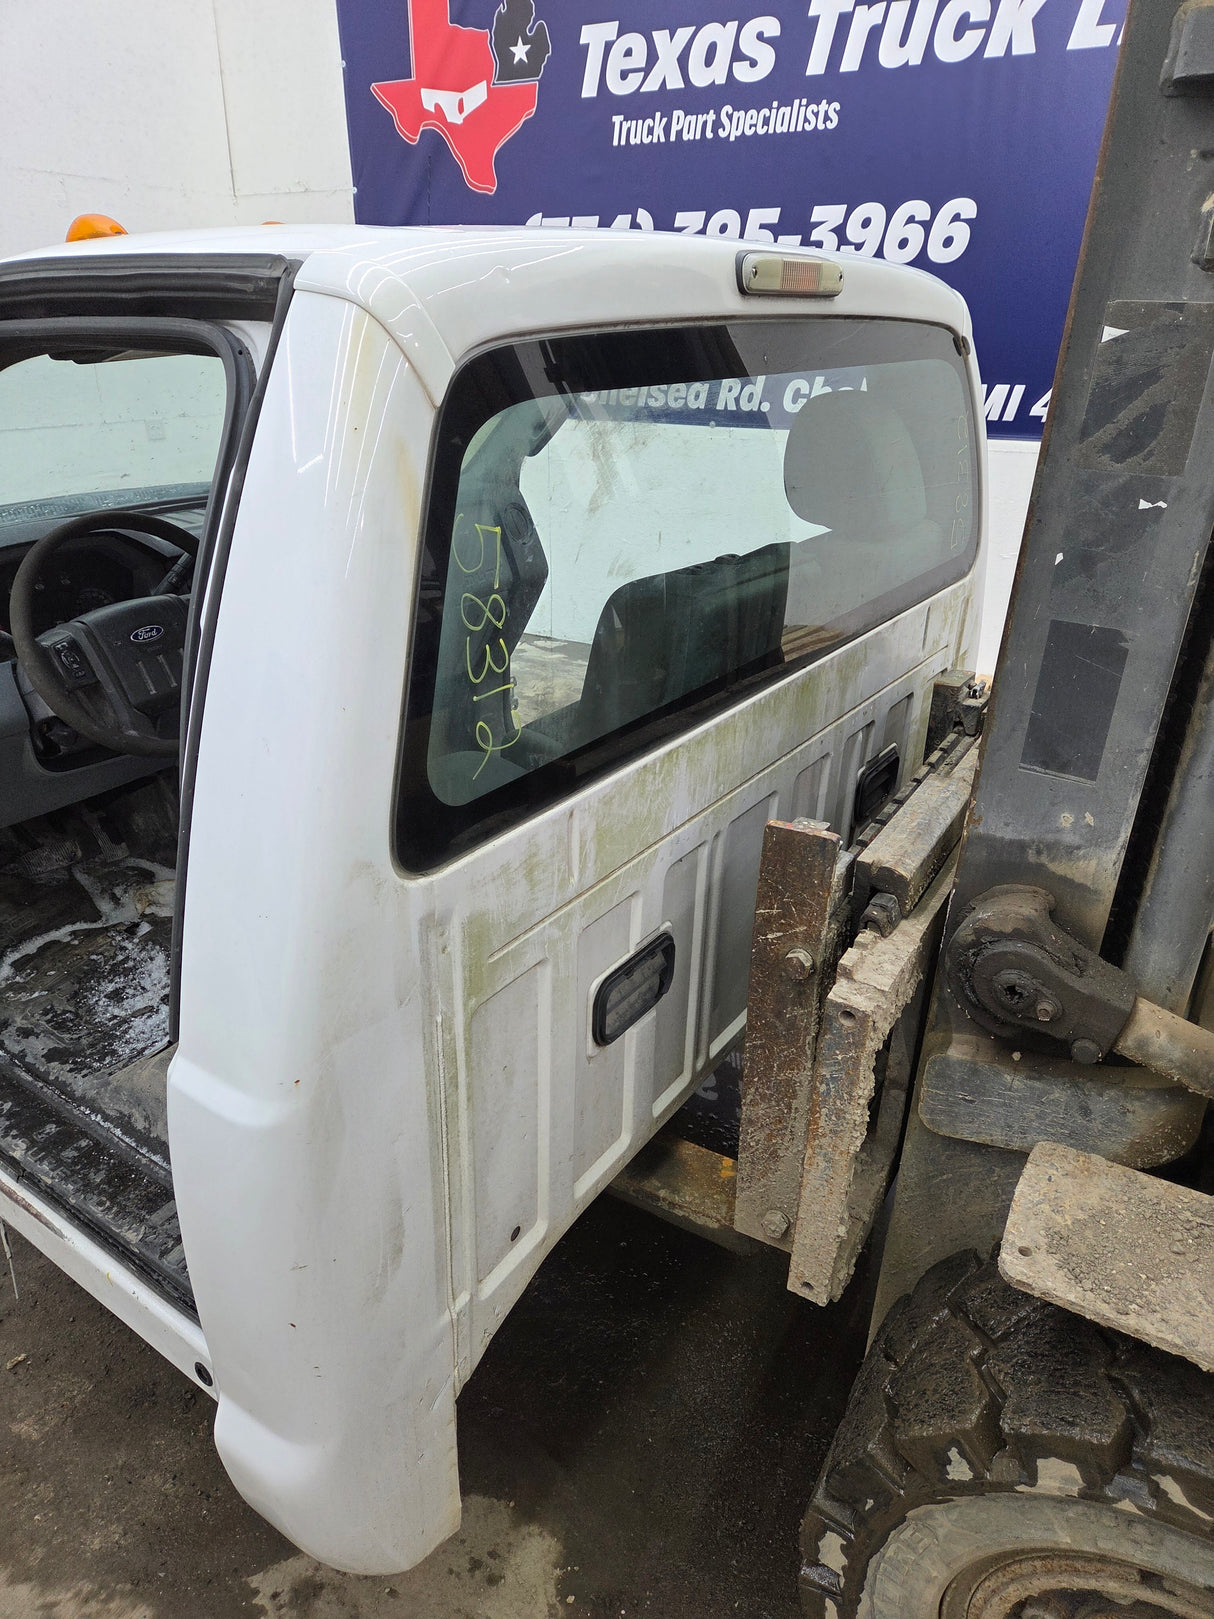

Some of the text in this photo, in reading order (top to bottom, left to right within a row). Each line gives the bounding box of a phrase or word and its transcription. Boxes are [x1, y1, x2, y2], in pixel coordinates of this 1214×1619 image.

[579, 0, 1126, 99] Texas Truck L
[611, 97, 841, 147] Truck Part Specialists
[715, 375, 771, 412] Rd.
[981, 384, 1026, 422] MI
[136, 626, 159, 640] Ford
[452, 513, 522, 781] 58312
